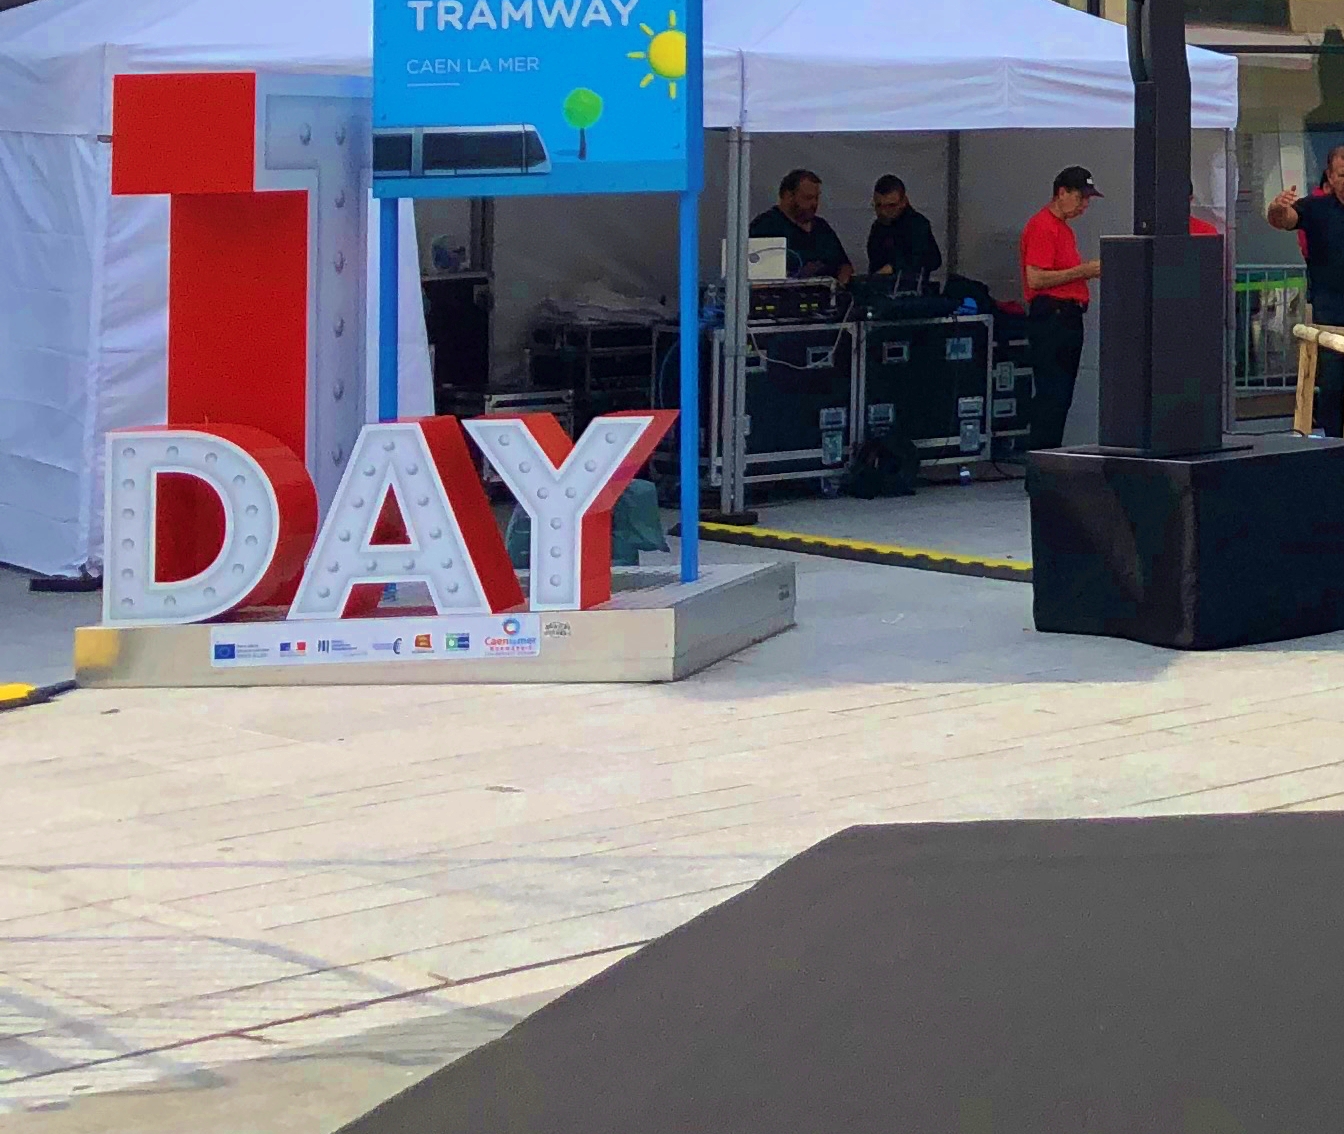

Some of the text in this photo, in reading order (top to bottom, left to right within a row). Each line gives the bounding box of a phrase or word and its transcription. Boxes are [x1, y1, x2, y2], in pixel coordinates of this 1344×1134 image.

[406, 56, 541, 76] CAEN LA MER
[103, 412, 680, 625] DAY
